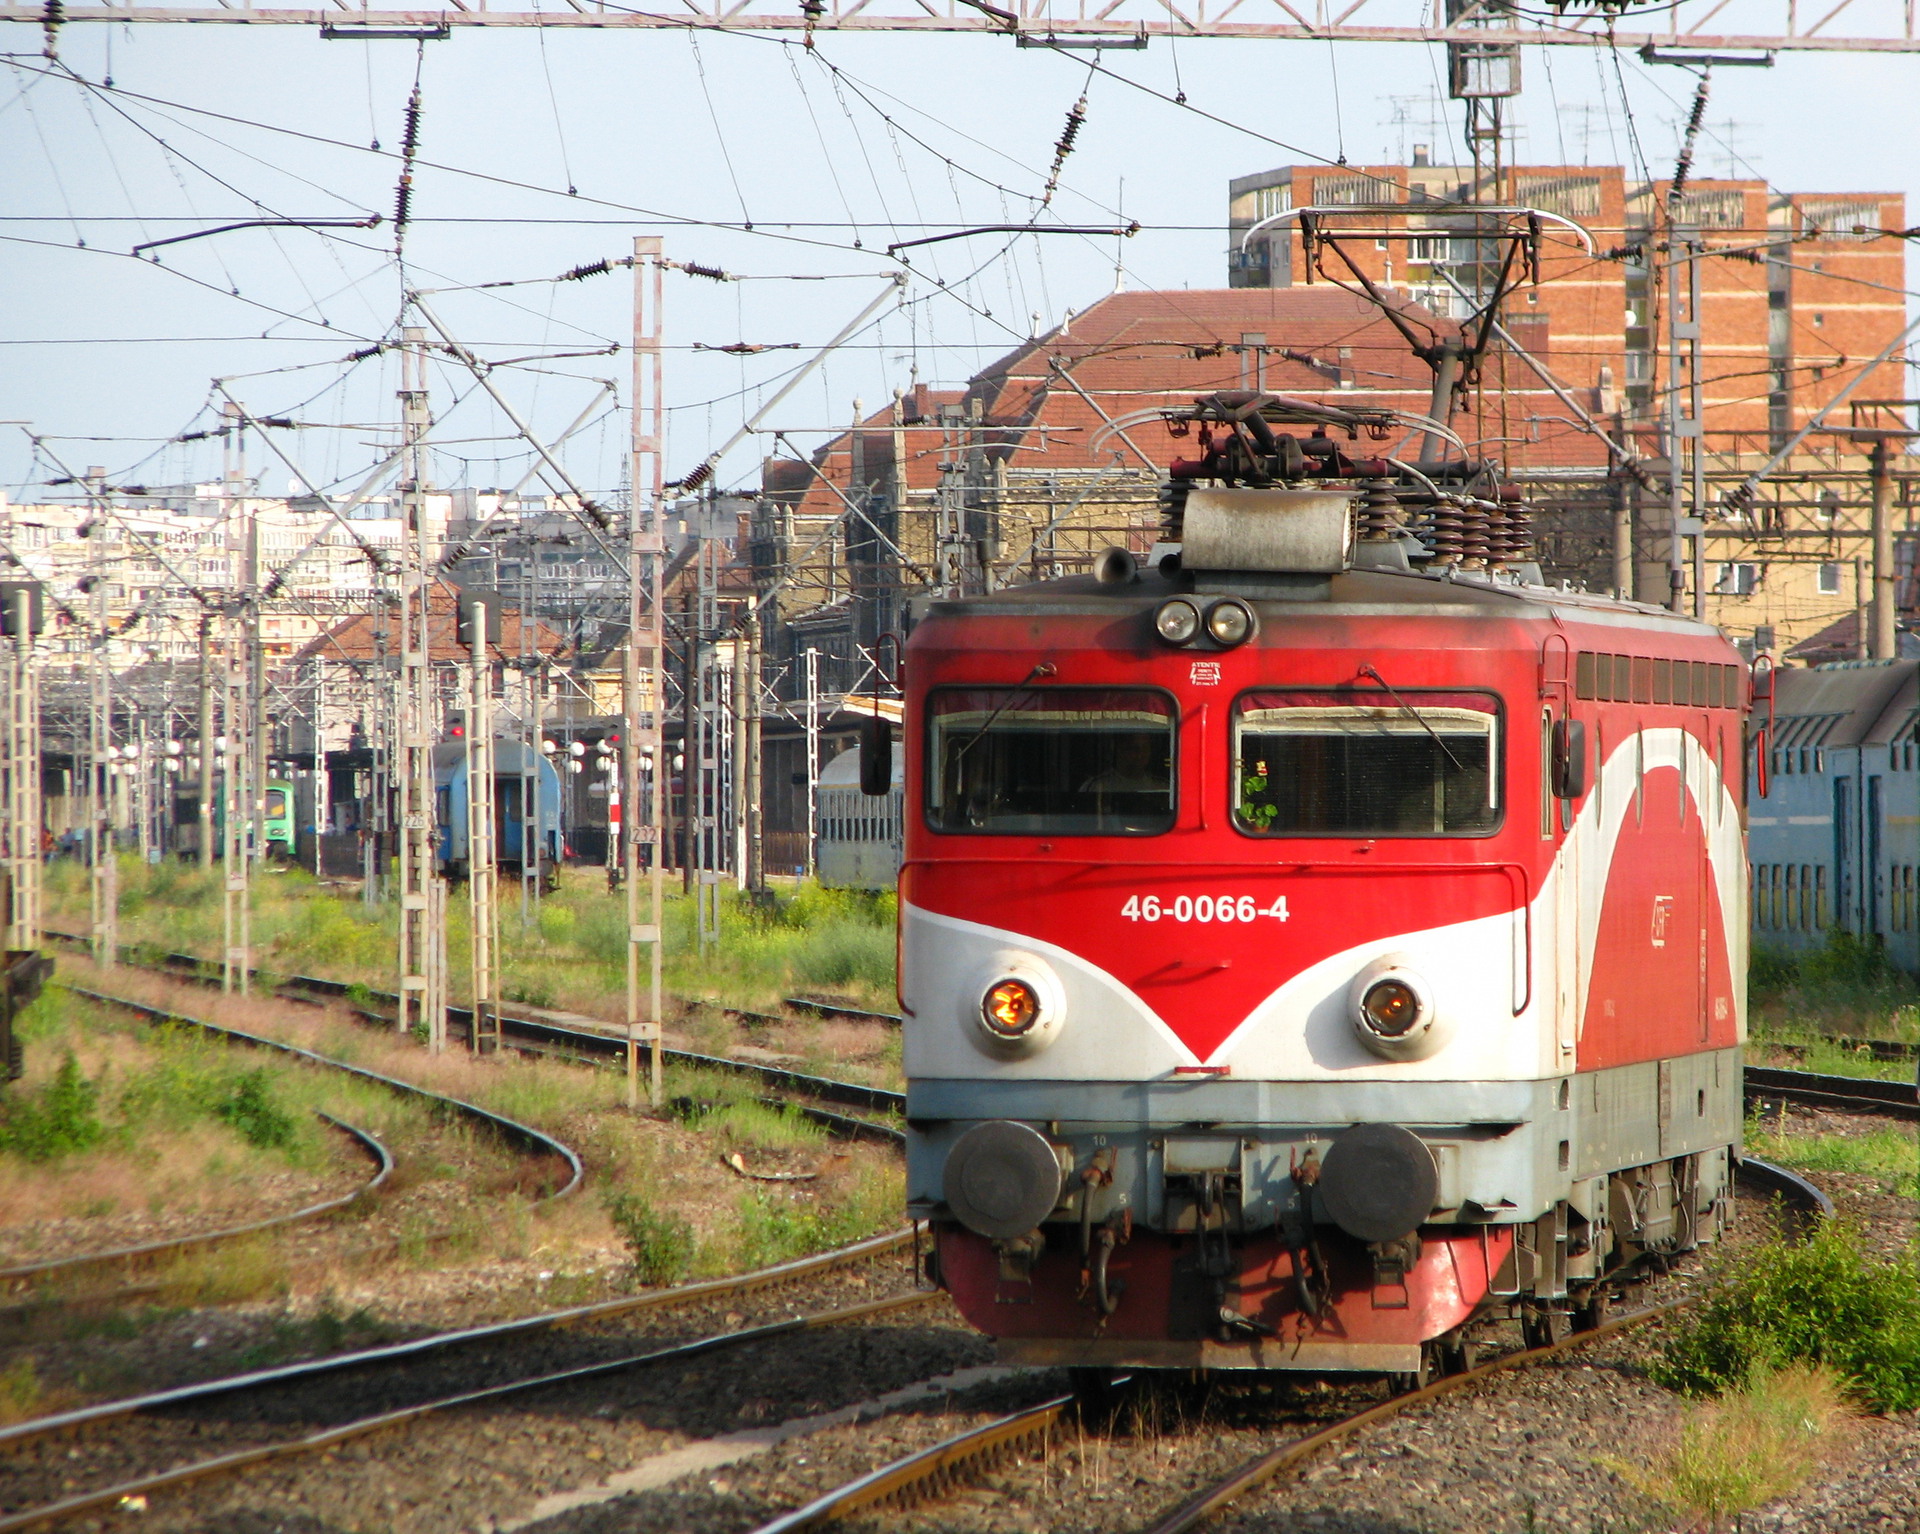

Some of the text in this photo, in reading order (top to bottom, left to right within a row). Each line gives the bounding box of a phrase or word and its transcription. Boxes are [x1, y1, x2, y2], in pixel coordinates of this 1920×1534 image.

[632, 827, 657, 842] 232
[1120, 894, 1291, 923] 46-0066-4
[1093, 1135, 1107, 1147] 10
[1119, 1193, 1127, 1204] 5
